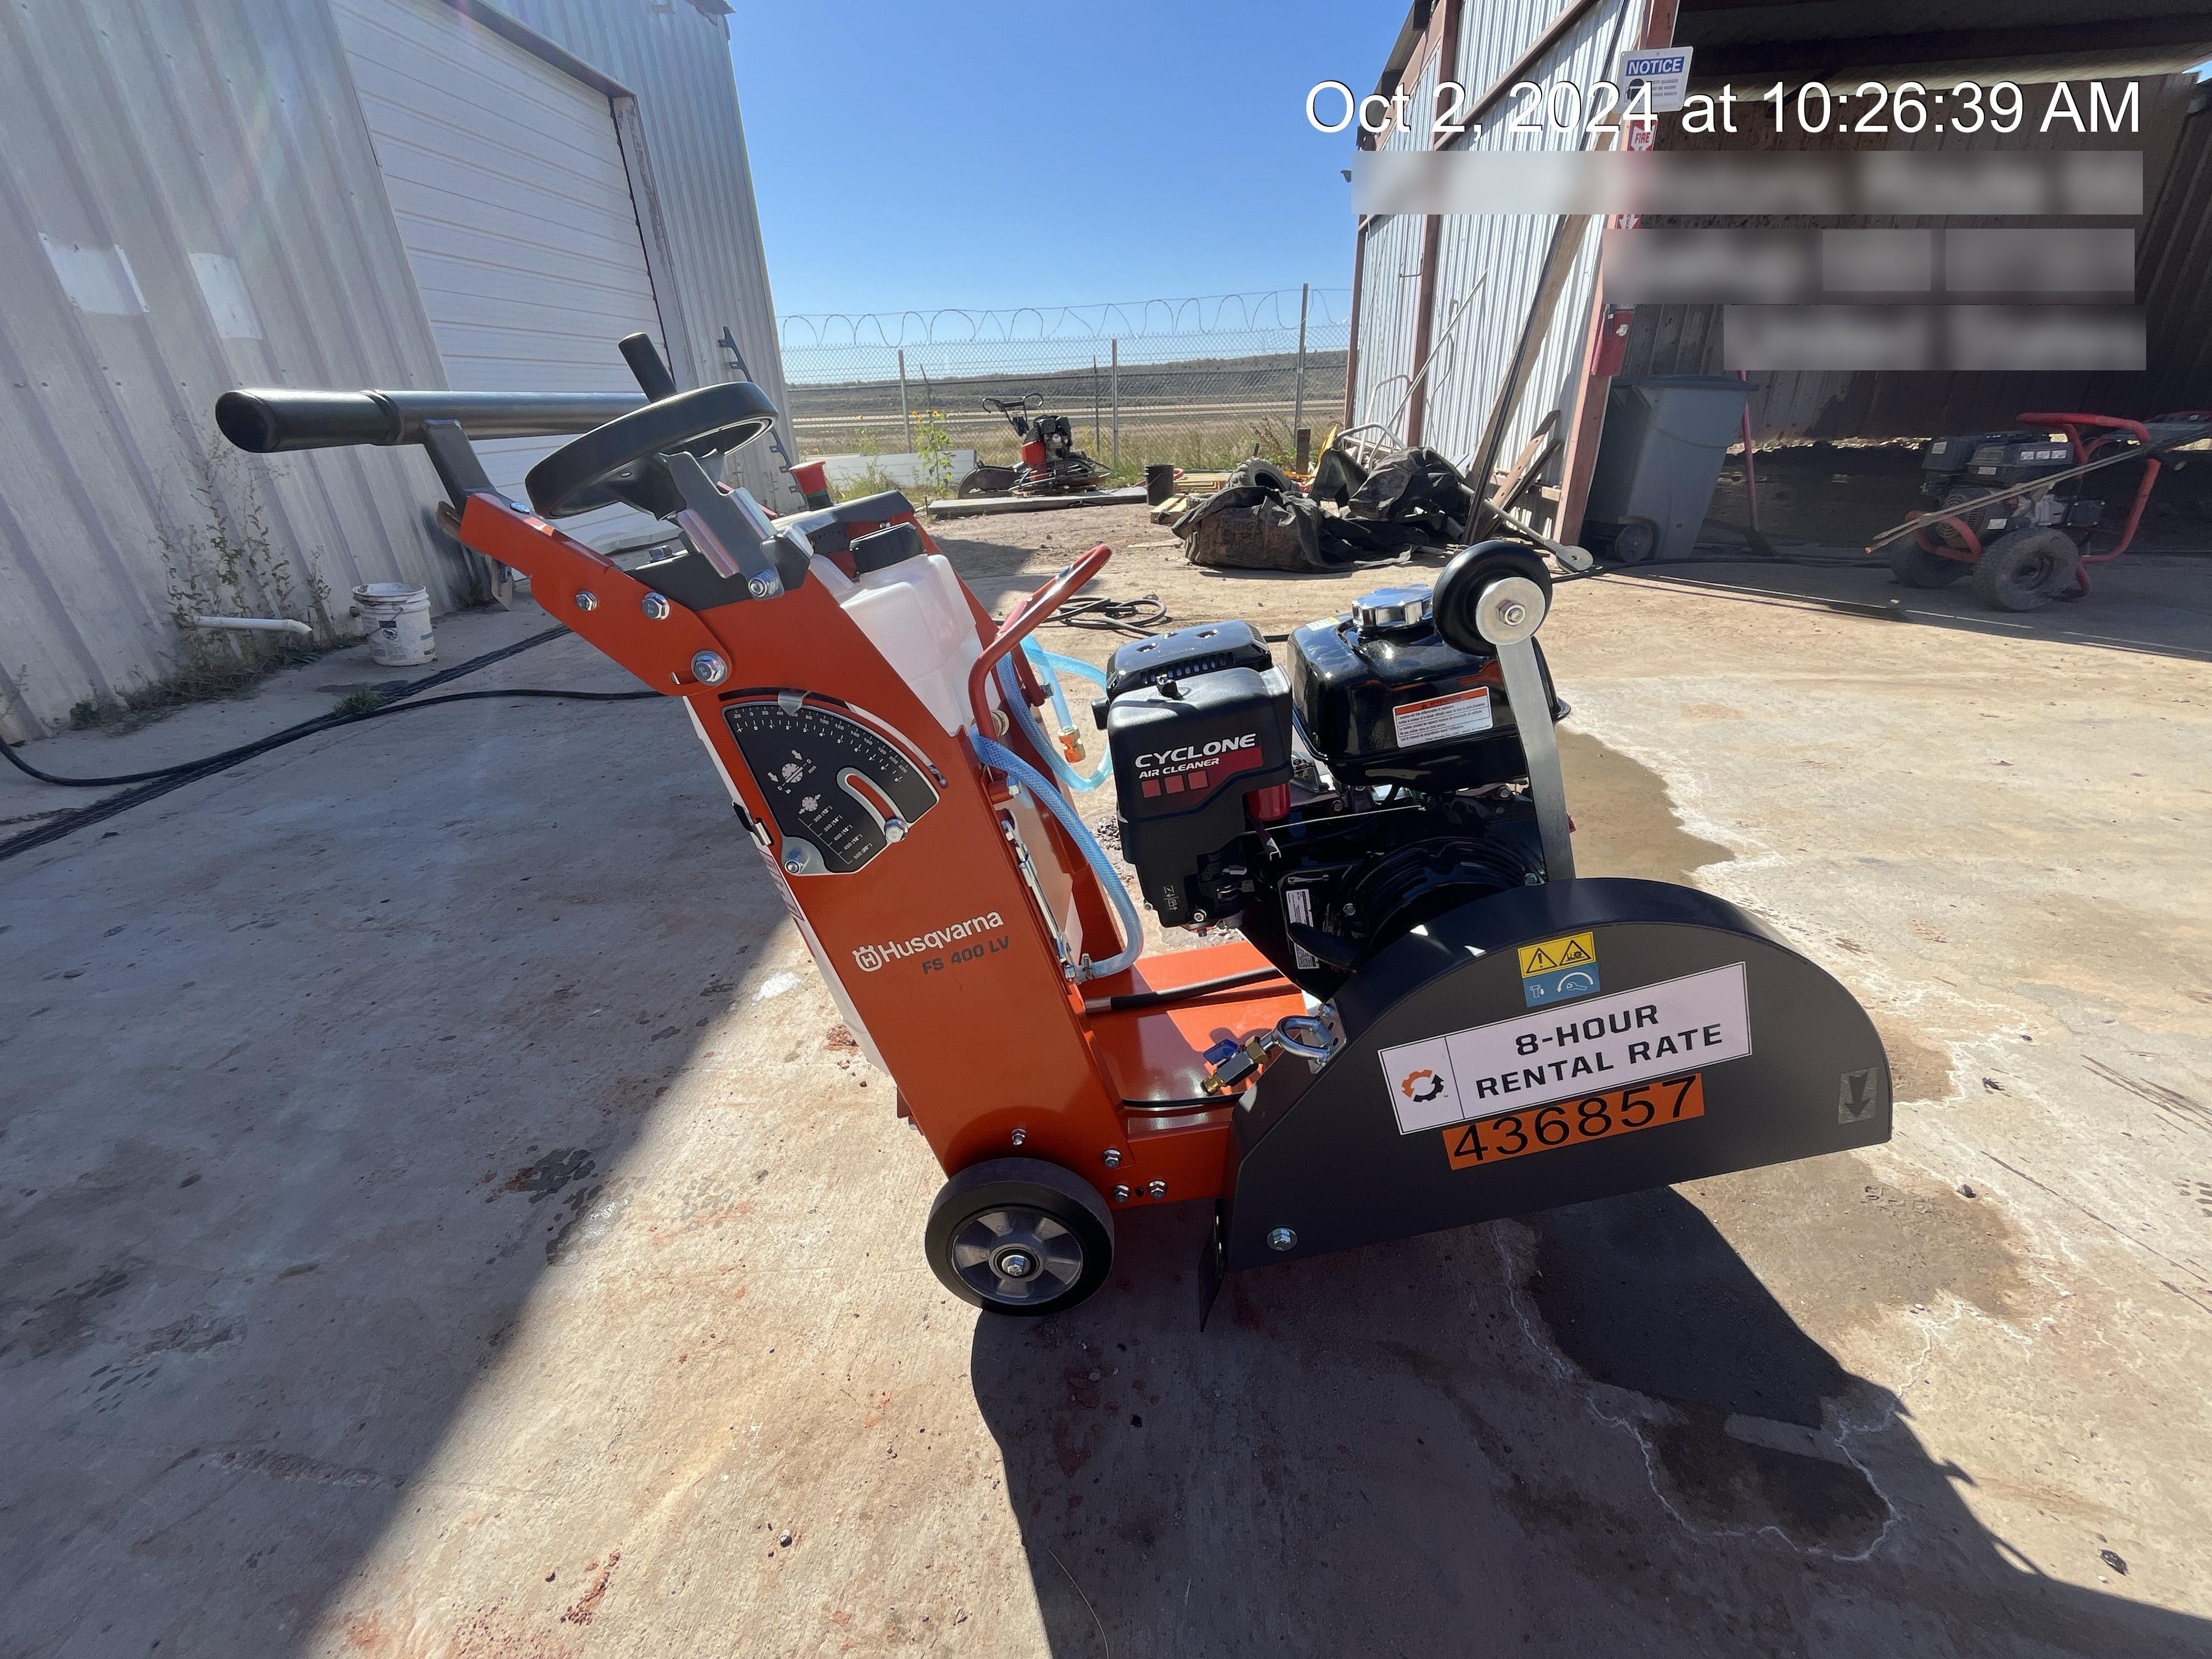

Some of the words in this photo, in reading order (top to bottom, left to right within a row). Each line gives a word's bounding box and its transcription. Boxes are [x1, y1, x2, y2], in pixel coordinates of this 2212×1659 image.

[1628, 58, 1682, 75] NOTICE
[1634, 132, 1651, 144] FIRE
[1135, 733, 1256, 768] CYCLONE
[1139, 769, 1160, 778] AIR
[1163, 758, 1220, 774] CLEANER
[878, 911, 1004, 962] Husqvarna
[922, 957, 944, 974] FS
[951, 944, 985, 964] 400
[989, 935, 1010, 953] LV
[1515, 1005, 1659, 1056] 8-HOUR
[1476, 1052, 1614, 1099] RENTAL
[1628, 1023, 1723, 1064] RATE
[1453, 1075, 1696, 1163] 436857
